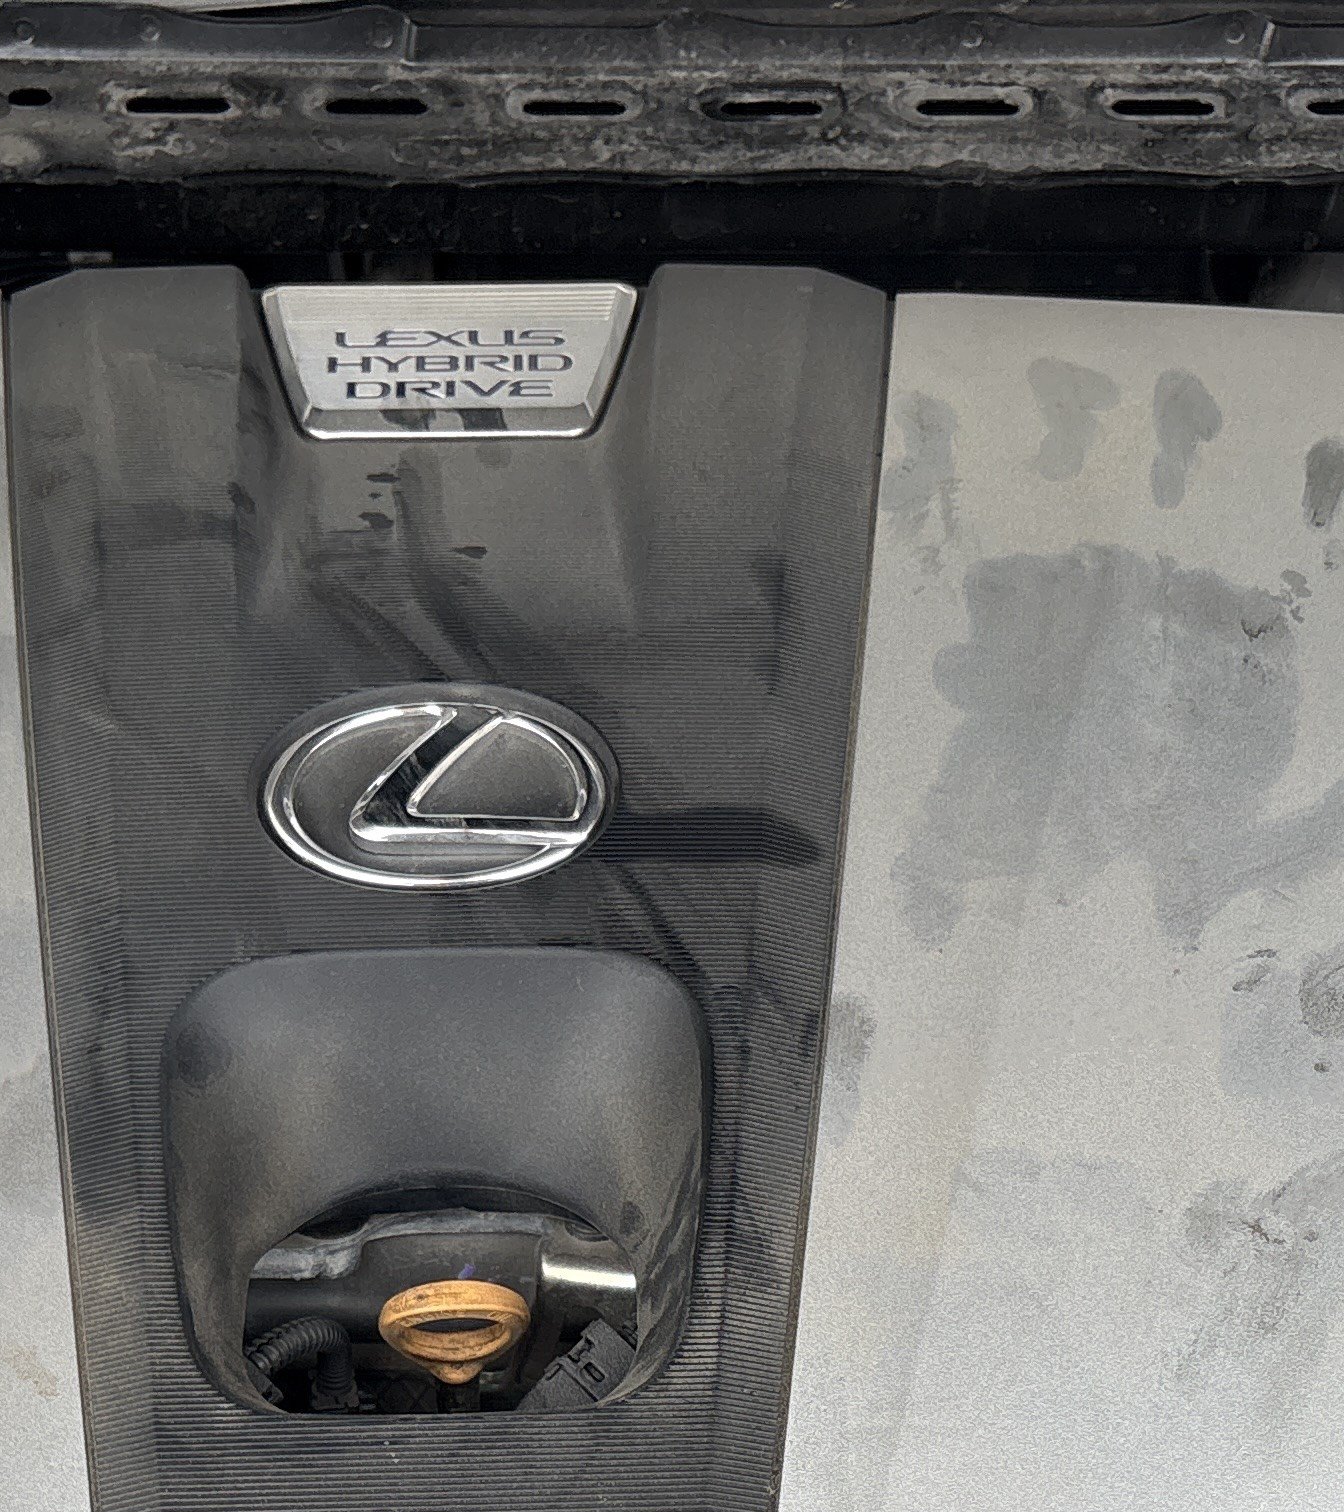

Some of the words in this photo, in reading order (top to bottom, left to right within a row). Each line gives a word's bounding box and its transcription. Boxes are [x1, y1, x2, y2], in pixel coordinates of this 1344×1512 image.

[334, 329, 567, 348] LEXUS
[326, 354, 574, 374] HYBRID
[345, 379, 556, 400] DRIVE
